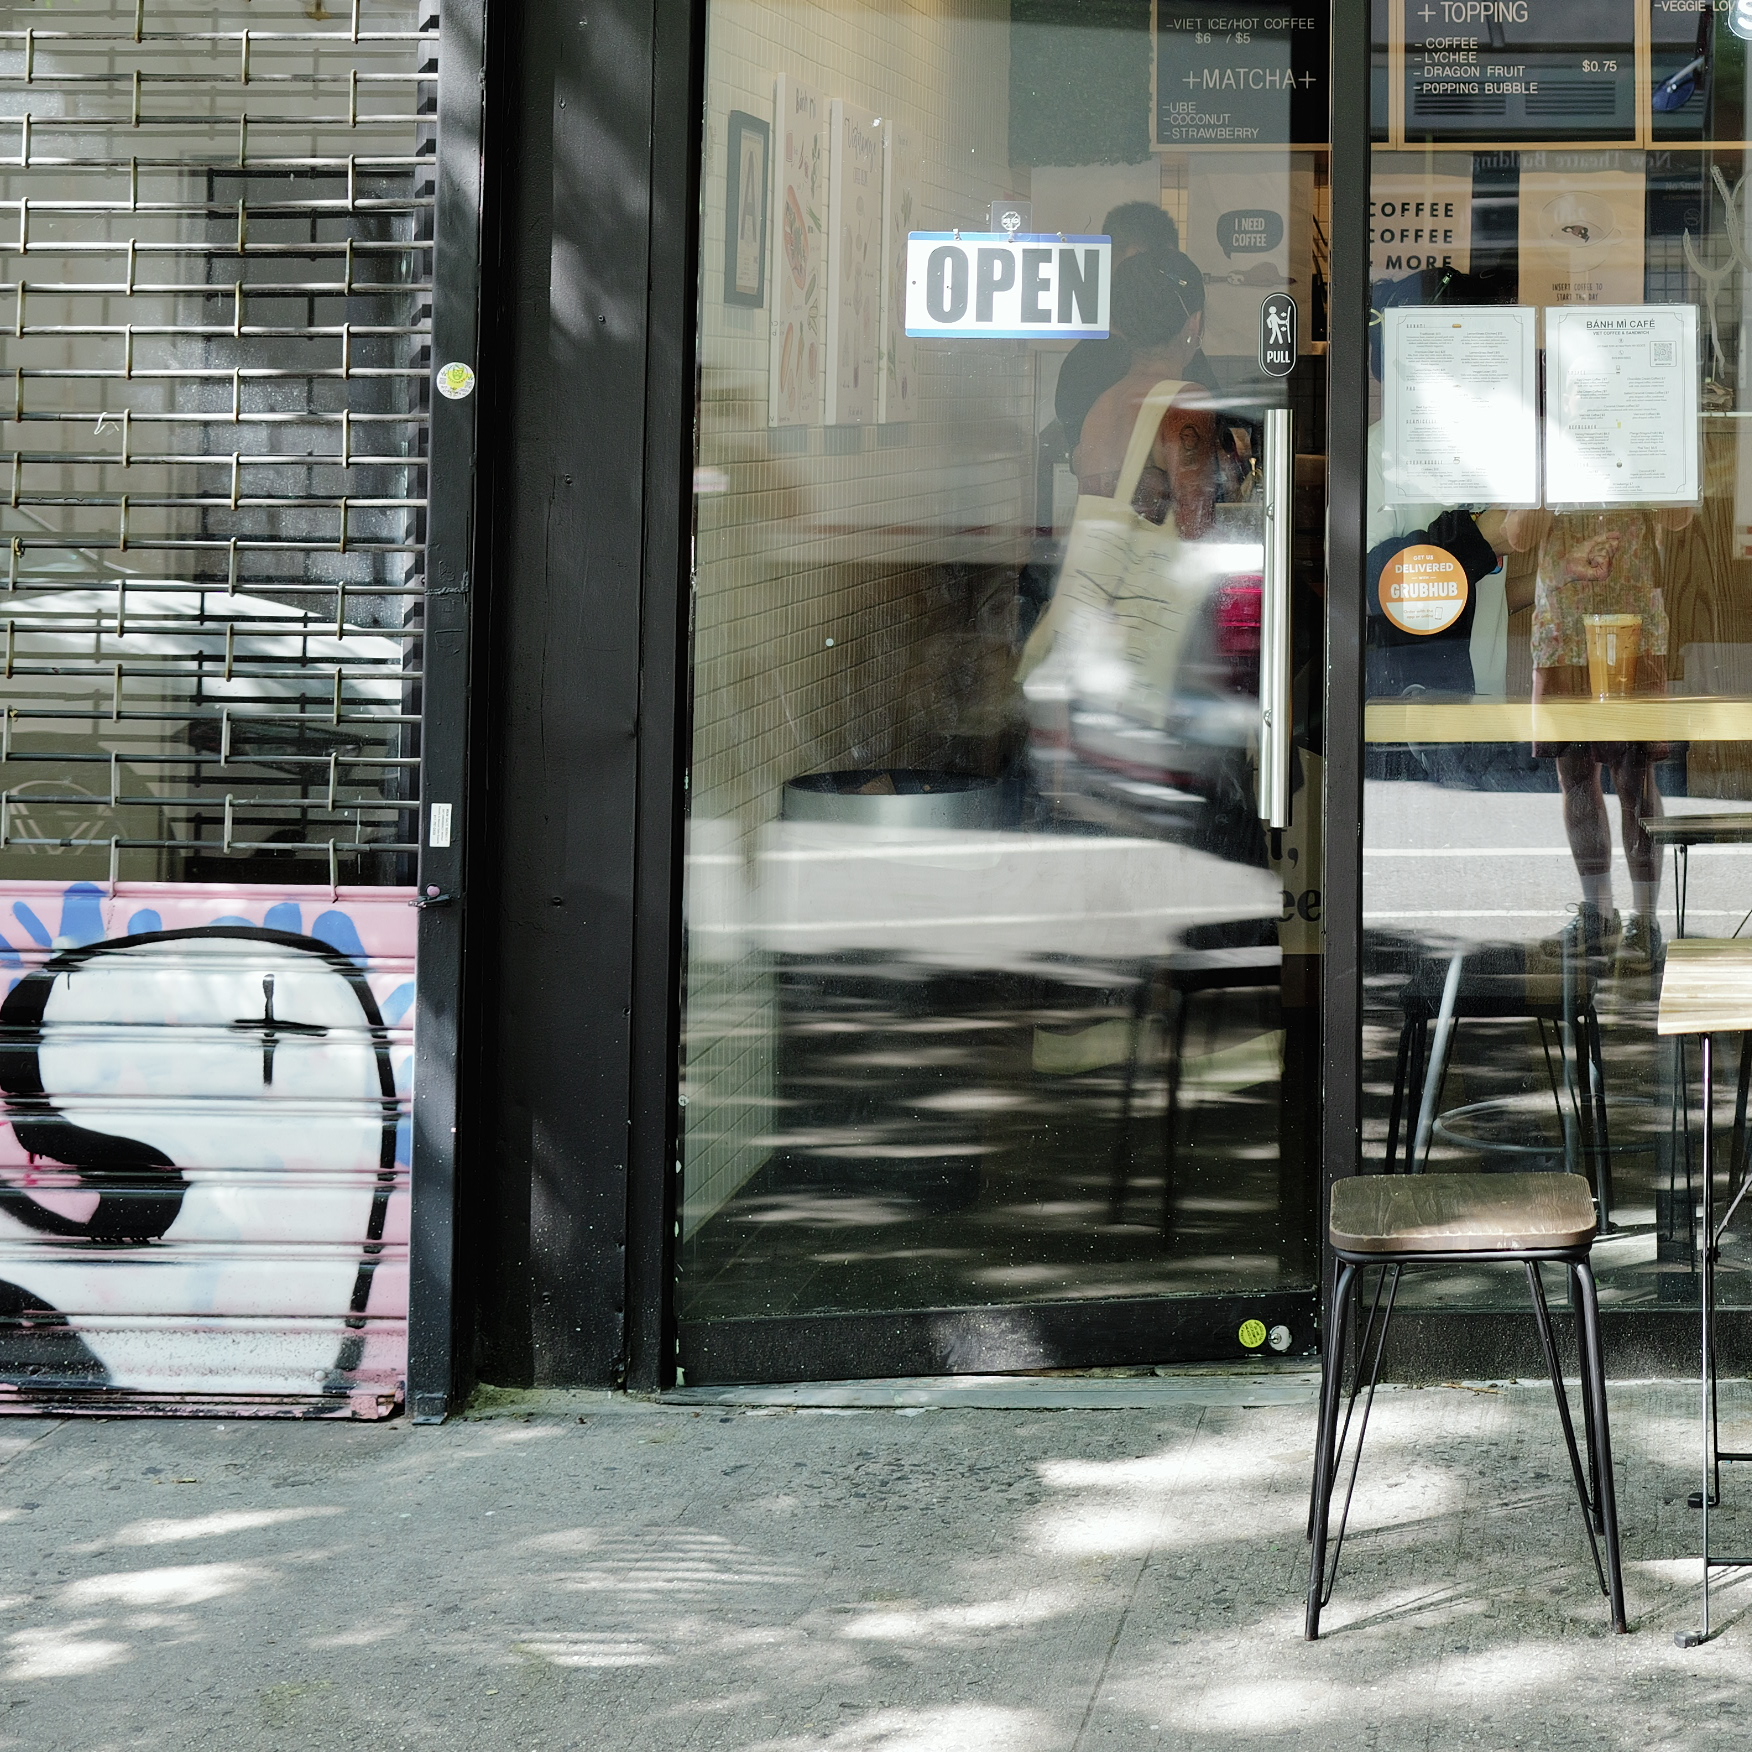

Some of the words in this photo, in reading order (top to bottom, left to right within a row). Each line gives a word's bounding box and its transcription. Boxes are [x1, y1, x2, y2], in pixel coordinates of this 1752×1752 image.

[1208, 18, 1259, 30] ICE/HOT
[1264, 18, 1315, 30] COFFEE
[1195, 32, 1211, 44] $6
[1235, 32, 1251, 44] $5
[1487, 66, 1525, 77] FRUIT
[1485, 82, 1538, 94] BUBBLE
[1241, 217, 1265, 231] NEED
[1232, 233, 1267, 246] COFFEE
[1386, 255, 1452, 270] MORE
[926, 245, 1100, 324] OPEN
[1552, 282, 1571, 291] INSERT
[1573, 282, 1593, 291] COFFEE
[1595, 282, 1603, 291] TO
[1586, 319, 1613, 329] BÁNH
[1616, 319, 1627, 328] MÌ
[1629, 318, 1655, 328] CAFÉ
[1266, 349, 1290, 364] PULL
[1395, 562, 1454, 574] DELIVERED
[1390, 581, 1458, 599] GRUBHUB
